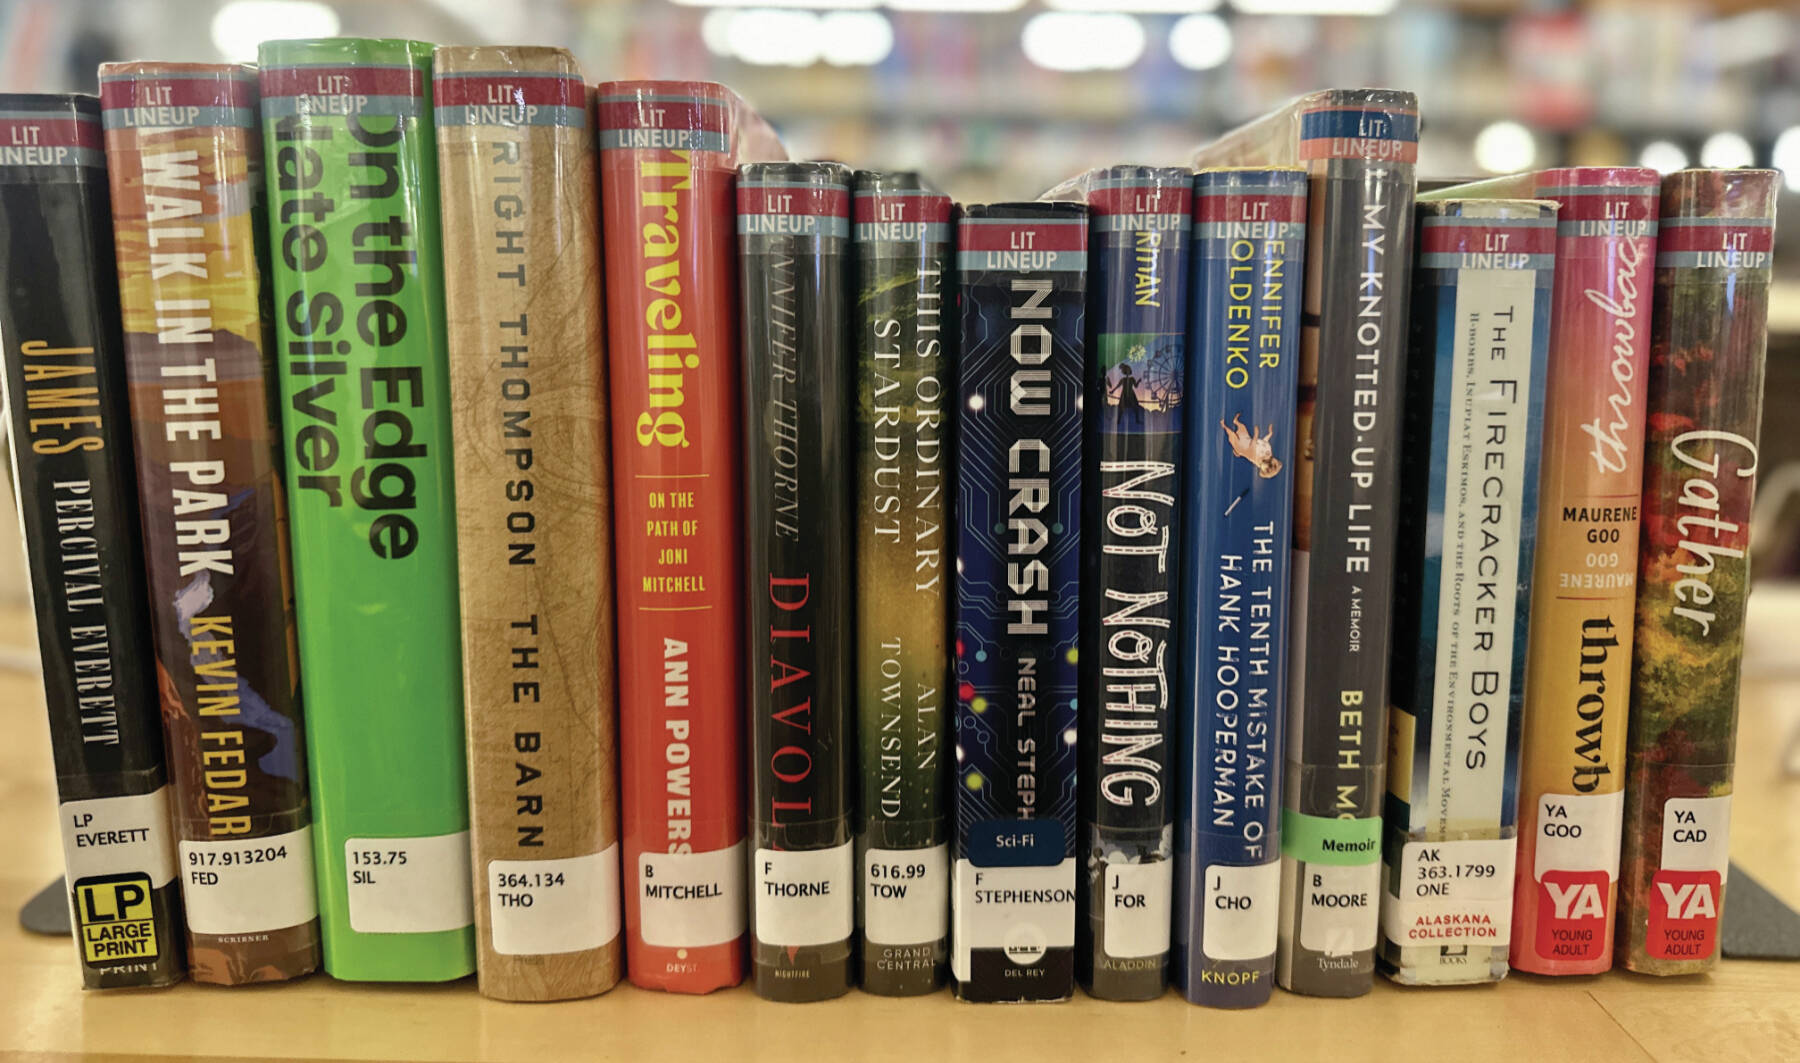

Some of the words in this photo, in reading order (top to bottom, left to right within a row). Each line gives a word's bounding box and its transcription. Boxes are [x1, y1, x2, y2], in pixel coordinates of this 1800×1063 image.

[317, 75, 343, 94] LIT
[487, 84, 514, 104] LIT
[145, 86, 172, 105] LIT
[295, 95, 368, 114] LINEUP
[124, 107, 200, 127] LINEUP
[465, 105, 538, 124] LINEUP
[639, 109, 666, 128] LIT
[12, 126, 40, 145] LIT
[1358, 119, 1384, 137] LIT
[618, 129, 690, 149] LINEUP
[1332, 138, 1403, 157] LINEUP
[492, 126, 525, 287] RIGHT
[767, 194, 793, 213] LIT
[880, 203, 905, 221] LIT
[1136, 194, 1161, 213] LIT
[1242, 202, 1270, 221] LIT
[1604, 202, 1630, 219] LIT
[141, 150, 208, 280] WALK
[746, 215, 816, 233] LINEUP
[1111, 214, 1180, 232] LINEUP
[860, 222, 927, 241] LINEUP
[1216, 222, 1290, 239] LINEUP
[1361, 204, 1386, 256] MY
[1579, 220, 1648, 237] LINEUP
[1010, 231, 1036, 250] LIT
[1485, 233, 1510, 252] LIT
[1722, 232, 1748, 250] LIT
[987, 252, 1058, 269] LINEUP
[1461, 253, 1530, 270] LINEUP
[1696, 252, 1766, 268] LINEUP
[352, 216, 418, 347] the
[636, 150, 700, 449] Traveling
[916, 260, 942, 358] THIS
[1259, 240, 1285, 369] ENNIFER
[154, 300, 214, 344] IN
[1225, 239, 1255, 389] OLDENKO
[1491, 305, 1514, 361] THE
[1010, 279, 1053, 416] NOW
[21, 340, 106, 456] JAMES
[160, 358, 222, 442] THE
[285, 290, 351, 508] Silver
[500, 313, 536, 566] THOMPSON
[873, 319, 901, 544] STARDUST
[350, 366, 428, 560] Edge
[773, 399, 799, 543] THORNE
[915, 376, 942, 596] ORDINARY
[649, 492, 665, 508] ON
[669, 492, 695, 508] THE
[169, 461, 235, 577] PARK
[1100, 461, 1175, 574] NOT
[1473, 379, 1517, 652] FIRECRACKER
[1562, 505, 1638, 523] MAURENE
[646, 520, 679, 536] PATH
[682, 520, 698, 536] OF
[1007, 438, 1051, 635] CRASH
[1586, 528, 1620, 543] GOO
[1671, 429, 1758, 637] Gather
[53, 479, 105, 614] PERCIVAL
[1252, 520, 1275, 573] THE
[1346, 504, 1373, 573] LIFE
[658, 548, 688, 564] JONI
[642, 576, 706, 592] MITCHELL
[1218, 554, 1243, 633] HANK
[1352, 585, 1363, 594] A
[1248, 586, 1272, 676] TENTH
[1349, 599, 1363, 653] MEMOIR
[189, 616, 241, 718] KEVIN
[511, 614, 541, 704] THE
[664, 637, 689, 707] ANN
[68, 622, 121, 748] EVERETT
[1017, 658, 1037, 727] NEAL
[1100, 588, 1172, 807] NOTHING
[1571, 615, 1620, 793] throwb
[769, 572, 812, 852] DIAVOL
[1466, 671, 1499, 770] BOYS
[880, 637, 901, 818] TOWNSEND
[917, 682, 936, 769] ALAN
[1337, 690, 1364, 769] BETH
[1212, 645, 1240, 827] HOOPERMAN
[1244, 688, 1268, 809] MISTAKE
[200, 730, 252, 836] FEDAR
[514, 732, 545, 848] BARN
[665, 720, 692, 855] POWERS
[74, 813, 93, 828] LP
[1544, 803, 1568, 819] YA
[1674, 810, 1696, 824] YA
[76, 828, 150, 848] EVERETT
[1243, 821, 1264, 859] OF
[1543, 823, 1582, 838] GOO
[1673, 829, 1707, 843] CAD
[996, 834, 1035, 848] Sci-Fi
[1322, 838, 1376, 852] Memoir
[189, 846, 288, 867] 917.913204
[353, 851, 408, 866] 153.75
[1418, 849, 1440, 862] AK
[353, 870, 376, 885] SIL
[645, 864, 654, 878] B
[765, 862, 773, 875] F
[871, 864, 926, 879] 616.99
[1417, 865, 1496, 880] 363.1799
[191, 871, 219, 886] FED
[498, 872, 566, 888] 364.134
[975, 872, 984, 886] F
[1112, 875, 1120, 890] J
[1213, 876, 1221, 891] J
[1313, 874, 1322, 887] B
[645, 883, 723, 899] MITCHELL
[764, 881, 830, 897] THORNE
[871, 883, 907, 898] TOW
[975, 889, 1076, 904] STEPHENSON
[1416, 882, 1450, 897] ONE
[83, 883, 145, 922] LP
[498, 892, 534, 908] THO
[1115, 894, 1146, 908] FOR
[1215, 896, 1251, 910] CHO
[1311, 893, 1368, 907] MOORE
[1543, 881, 1605, 919] YA
[1656, 881, 1717, 919] YA
[1416, 914, 1492, 926] ALASKANA
[86, 922, 152, 942] LARGE
[1409, 927, 1497, 939] COLLECTION
[1551, 929, 1593, 941] YOUNG
[1664, 929, 1705, 941] YOUNG
[93, 939, 148, 957] PRINT
[1551, 944, 1590, 955] ADULT
[1664, 943, 1702, 955] ADULT
[1004, 968, 1023, 977] DEL
[1026, 968, 1046, 977] REY
[1317, 957, 1359, 972] Tyndale
[1201, 970, 1260, 985] KNOPF
